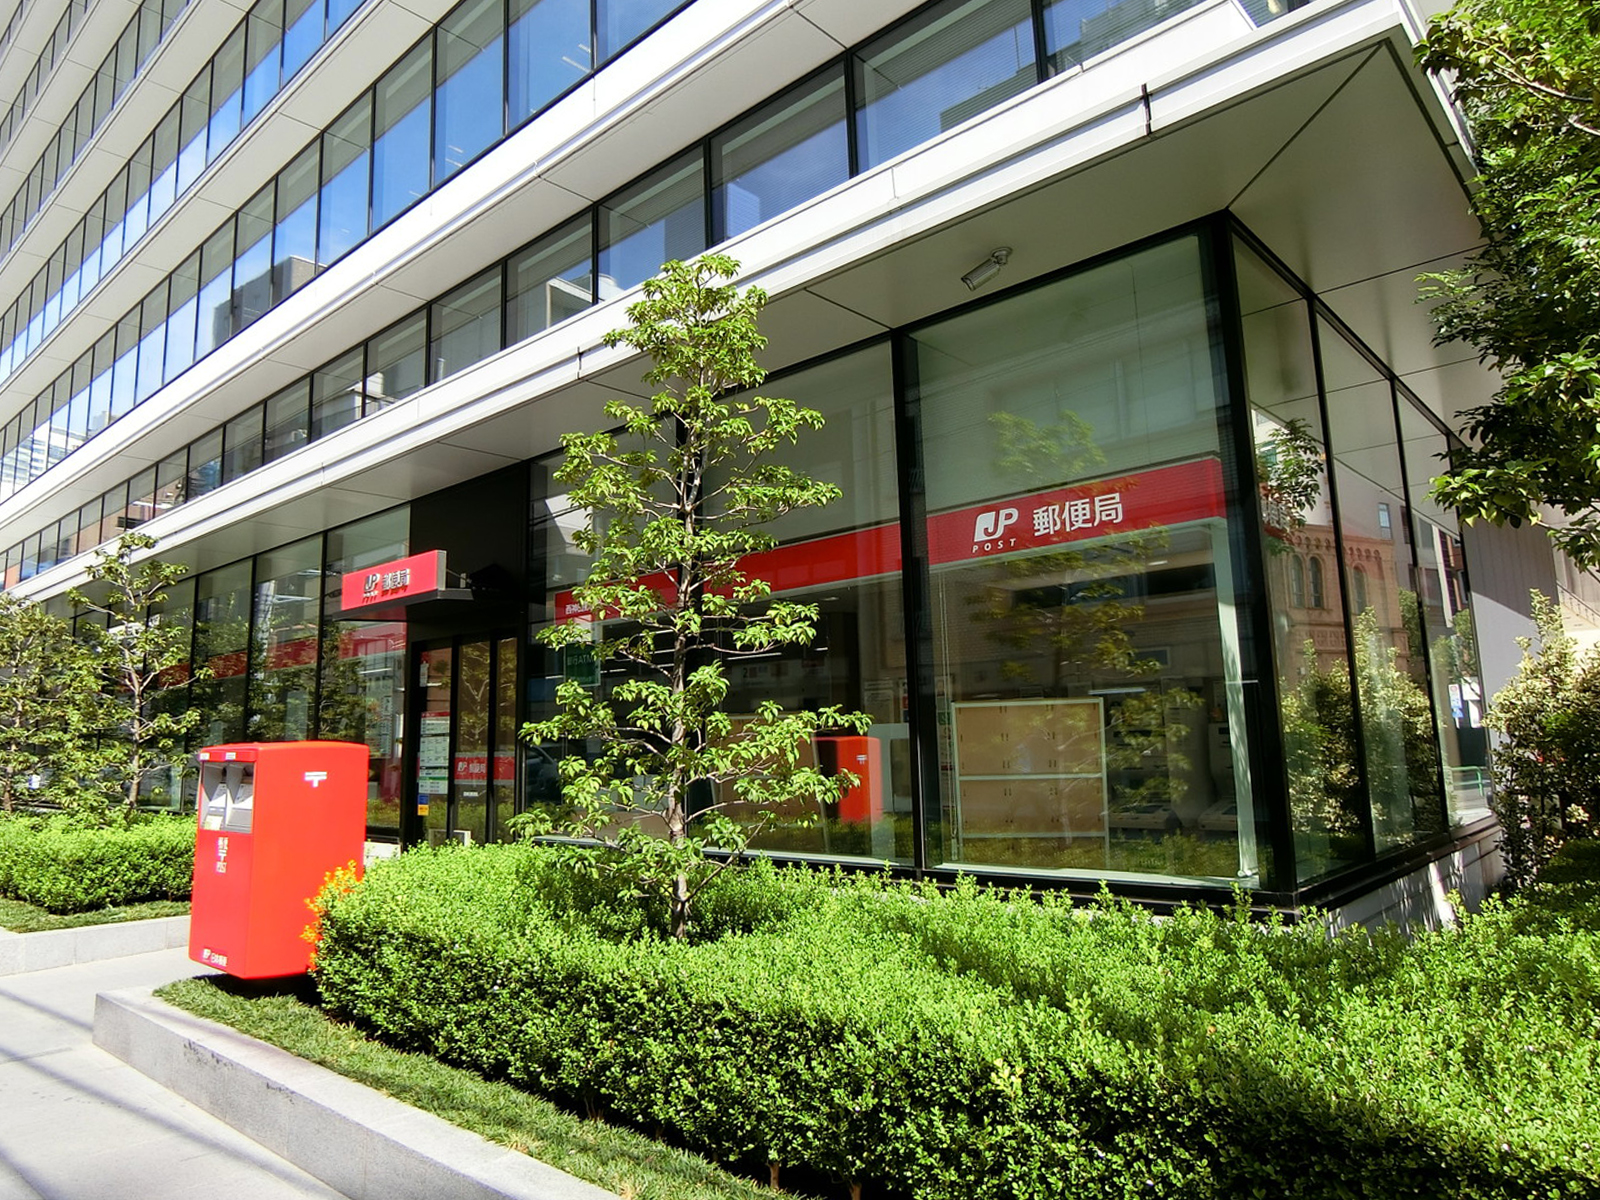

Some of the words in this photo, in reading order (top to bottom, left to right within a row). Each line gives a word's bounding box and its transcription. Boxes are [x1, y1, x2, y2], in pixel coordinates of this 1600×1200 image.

[973, 508, 1019, 543] JP
[1033, 492, 1124, 538] 郵便局
[971, 538, 1018, 554] POST
